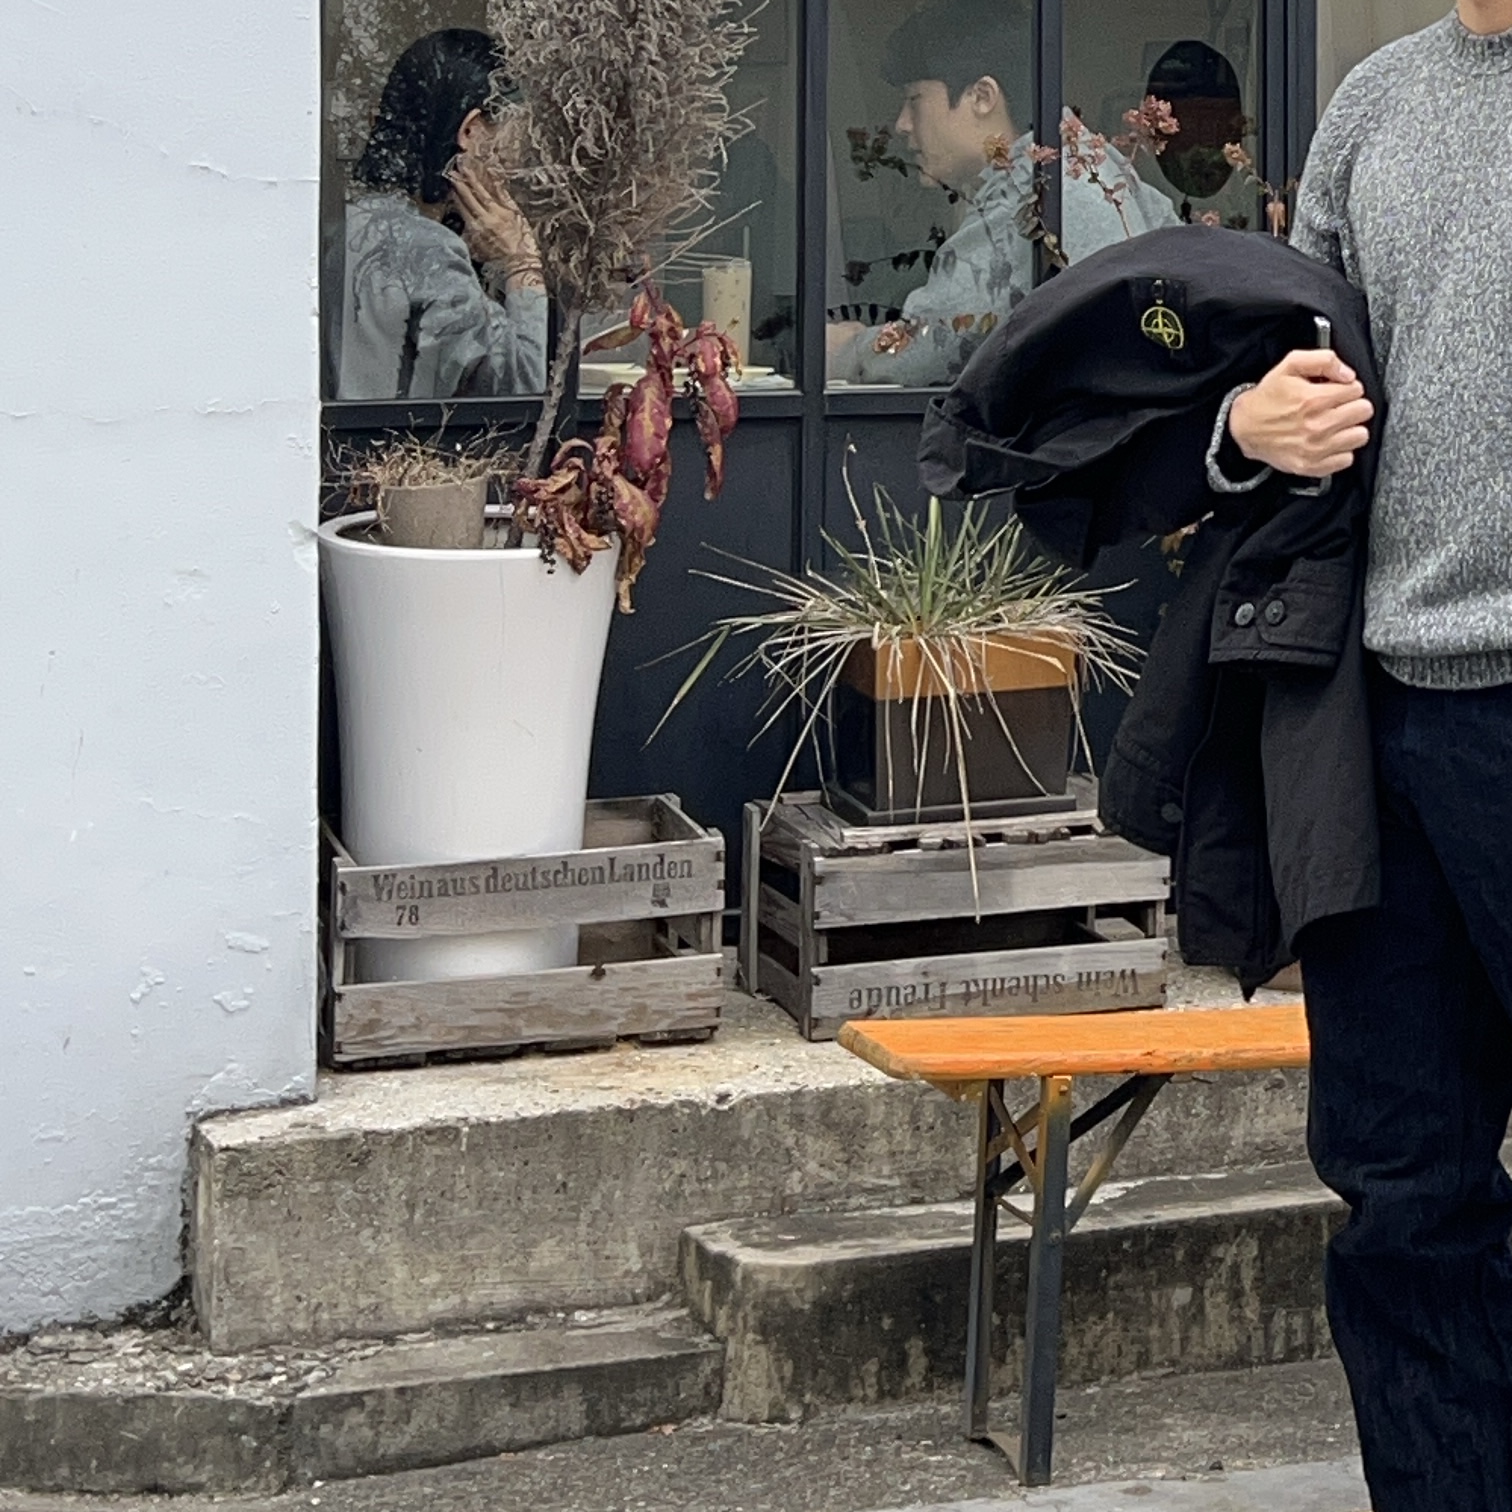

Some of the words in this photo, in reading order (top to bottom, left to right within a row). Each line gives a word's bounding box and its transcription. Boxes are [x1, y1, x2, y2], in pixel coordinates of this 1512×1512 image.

[371, 872, 434, 902] Wein
[436, 875, 481, 897] aus
[484, 860, 605, 894] deutschen
[607, 853, 693, 883] Landen
[396, 905, 420, 926] 78
[961, 972, 1065, 1007] schenkt
